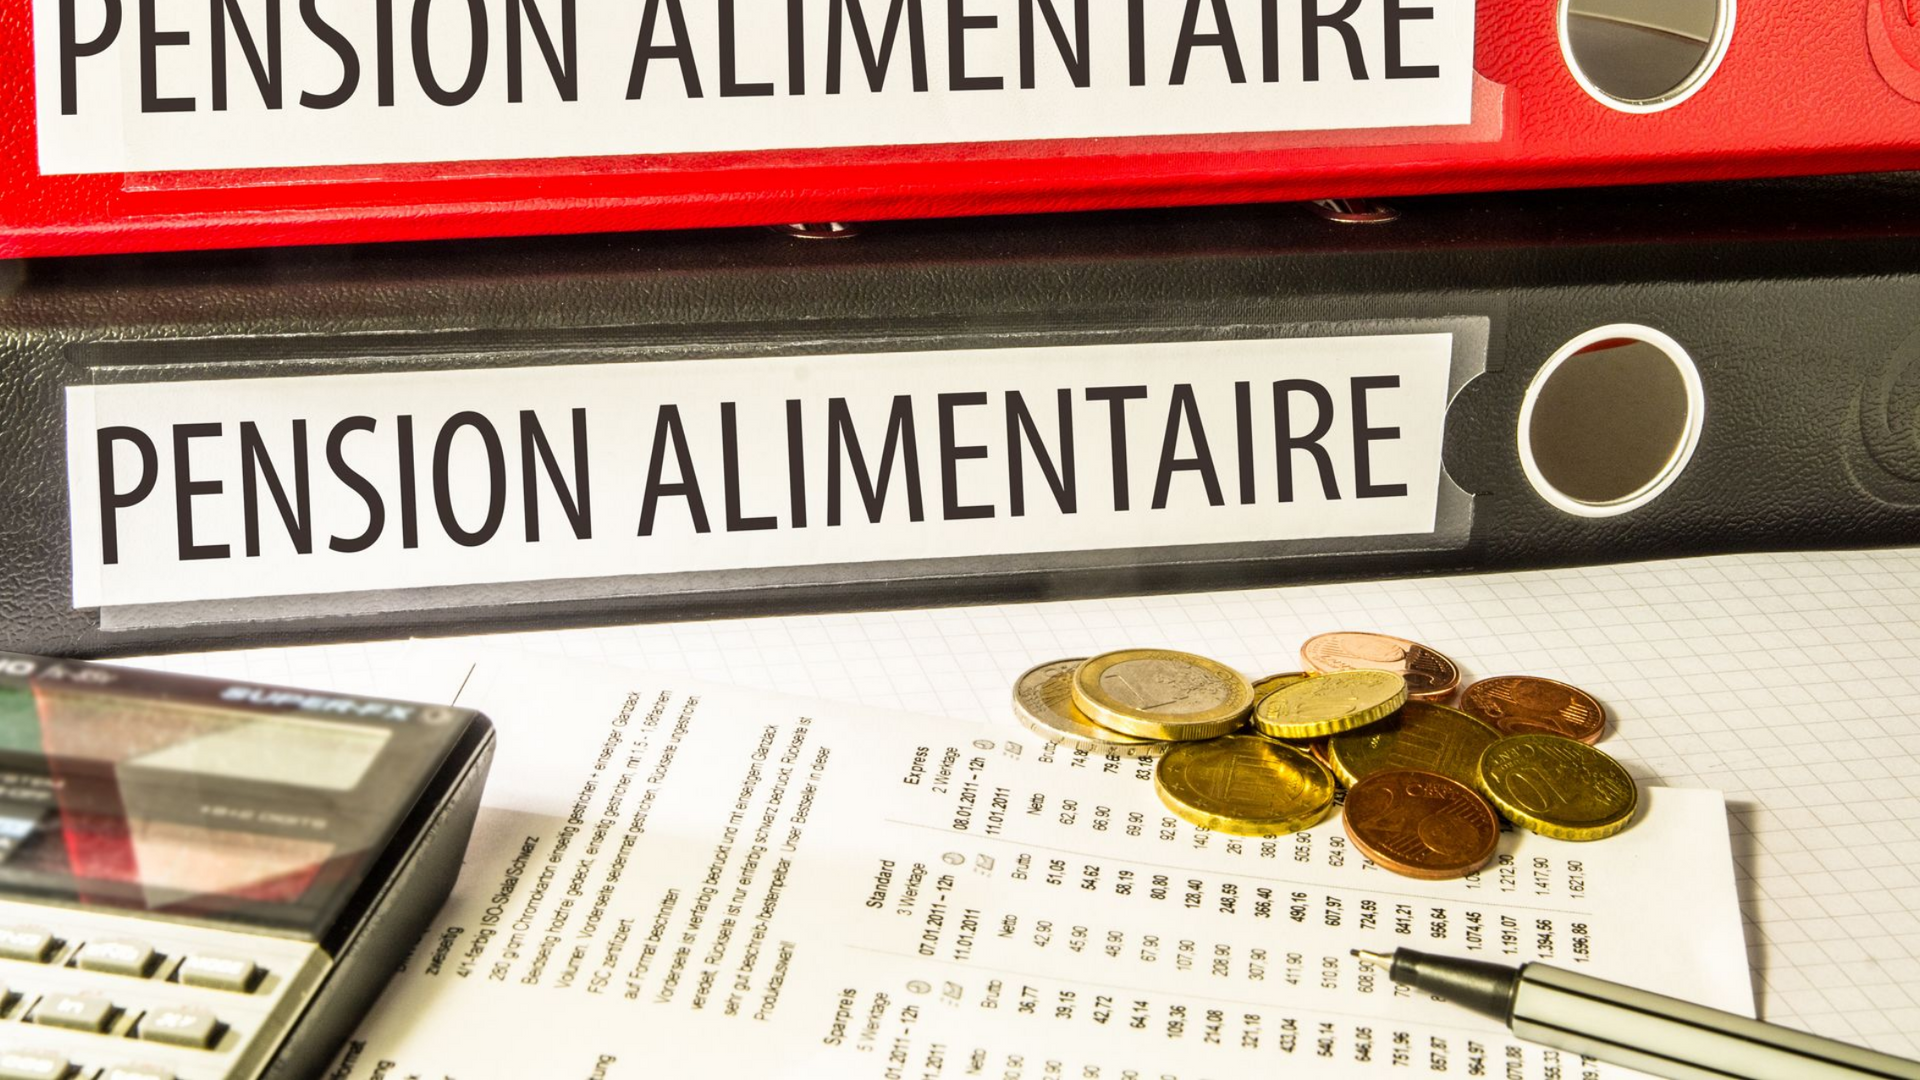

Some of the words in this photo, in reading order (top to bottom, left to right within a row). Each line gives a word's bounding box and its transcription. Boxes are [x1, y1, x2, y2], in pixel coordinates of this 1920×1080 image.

[61, 0, 579, 116] PENSION
[625, 0, 1441, 101] ALIMENTAIRE
[97, 407, 592, 565] PENSION
[637, 374, 1408, 537] ALIMENTAIRE
[902, 745, 930, 785] Express
[933, 746, 961, 785] Werktage
[930, 785, 947, 794] 2
[951, 781, 979, 830] 08.01.2011
[967, 756, 985, 771] 12h
[1025, 792, 1045, 815] Netto
[984, 786, 1010, 834] 11.01.2011
[1058, 798, 1078, 825] 62,90
[1091, 804, 1111, 831] 66,90
[1125, 811, 1144, 836] 69,90
[1158, 816, 1177, 841] 92,90
[1293, 828, 1311, 863] 505,90
[1327, 835, 1345, 867] 624,90
[1010, 852, 1032, 880] Brutto
[1045, 858, 1066, 885] 51,05
[1080, 864, 1100, 891] 54,62
[1494, 851, 1515, 892] 1.212,90
[1532, 856, 1551, 895] 1.417,90
[1566, 859, 1585, 898] 1.621,90
[864, 858, 895, 909] Standard
[897, 862, 928, 907] Werktage
[1114, 869, 1134, 896] 58,19
[1149, 874, 1169, 900] 80,80
[1183, 878, 1203, 908] 128,40
[1218, 882, 1238, 914] 248,59
[895, 908, 912, 916] 3
[917, 902, 947, 956] 07.01.2011
[935, 873, 954, 891] 12h
[1253, 886, 1273, 918] 366,40
[1288, 891, 1308, 923] 490,16
[1323, 894, 1343, 927] 607,97
[1359, 899, 1378, 930] 724,59
[953, 908, 980, 960] 11.01.2011
[997, 913, 1018, 937] Netto
[1033, 919, 1053, 947] 42,90
[1394, 903, 1414, 935] 841,21
[1429, 907, 1448, 939] 956,64
[1464, 910, 1483, 950] 1.074,45
[1499, 914, 1519, 954] 1.191,07
[1068, 924, 1088, 953] 45,90
[1104, 929, 1124, 958] 48,90
[1139, 934, 1159, 962] 67,90
[1534, 918, 1554, 958] 1.394,56
[1570, 922, 1590, 963] 1.596,86
[1175, 939, 1195, 970] 107,90
[1211, 943, 1231, 977] 208,90
[1247, 947, 1267, 981] 307,90
[1284, 952, 1303, 985] 411,90
[1319, 955, 1339, 989] 510,90
[979, 979, 1003, 1009] Brutto
[822, 987, 857, 1046] Sparpreis
[860, 991, 891, 1041] Werktage
